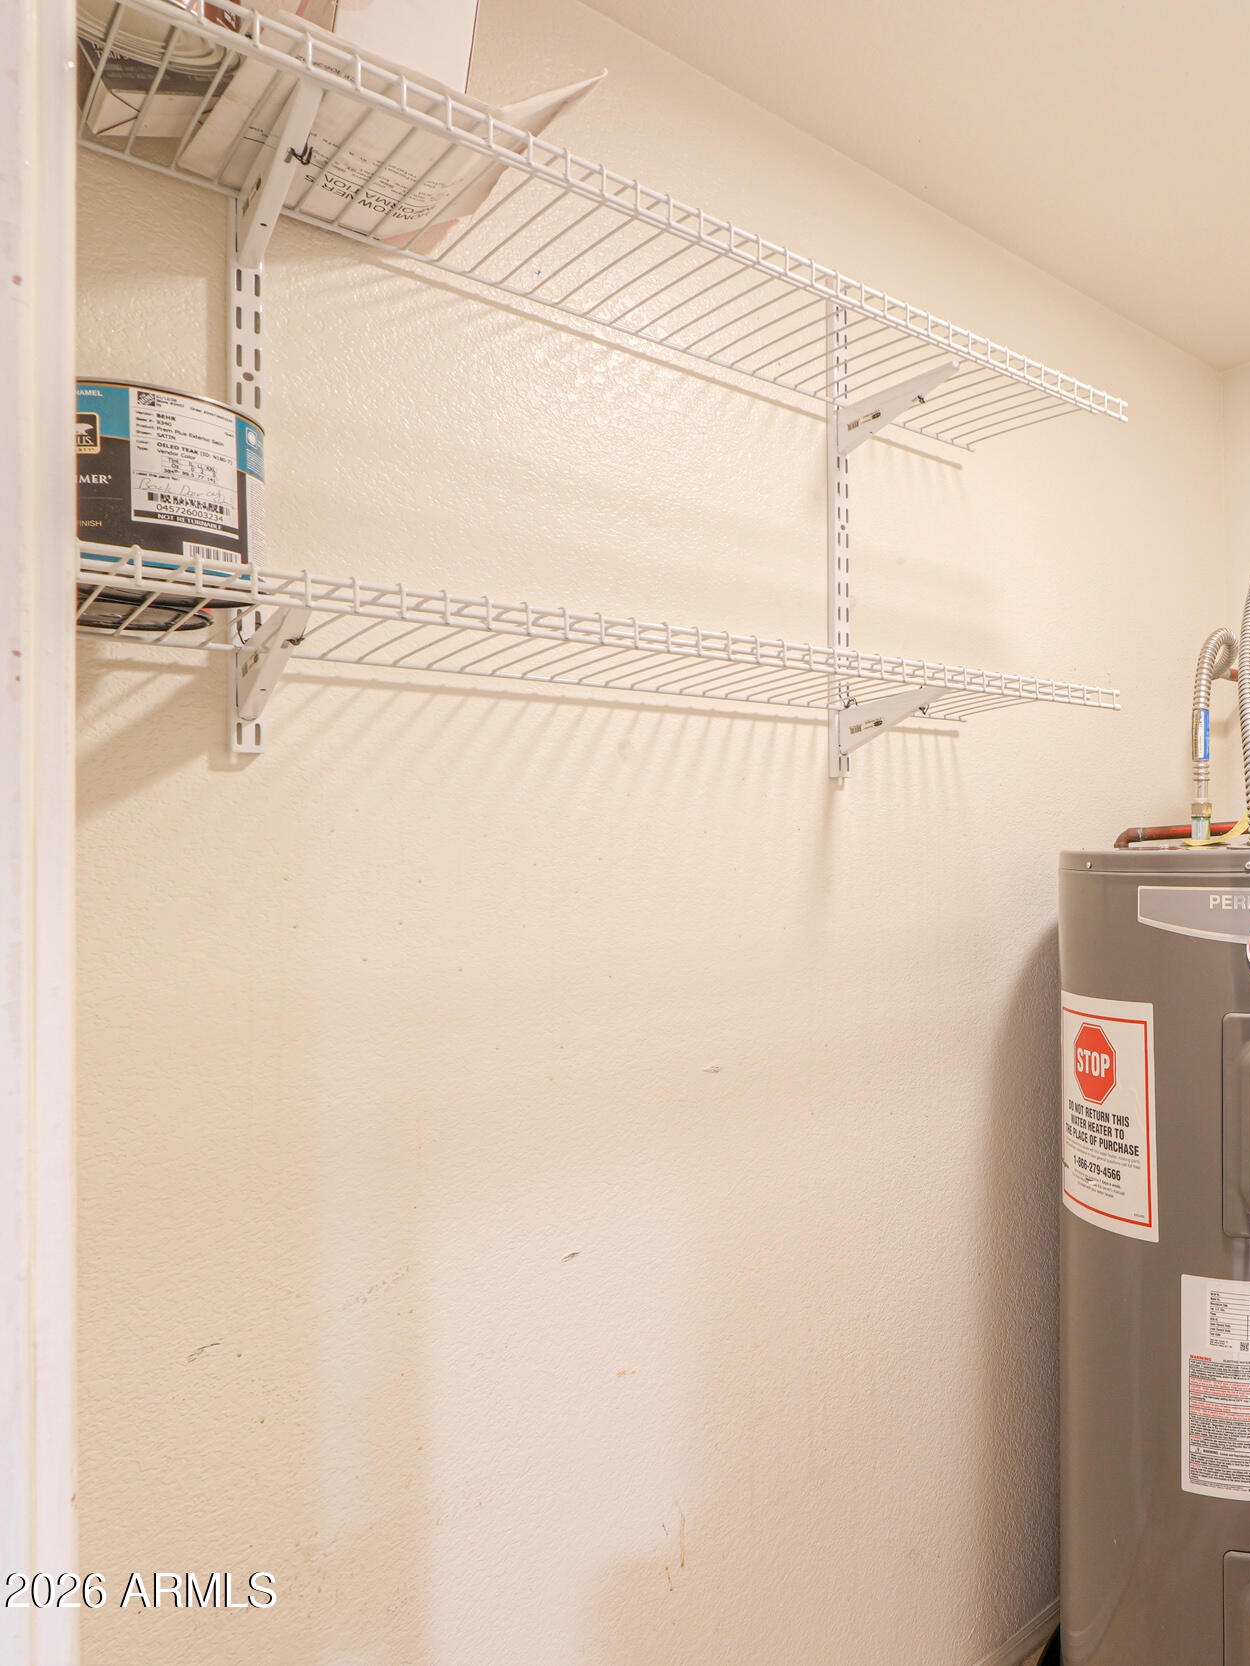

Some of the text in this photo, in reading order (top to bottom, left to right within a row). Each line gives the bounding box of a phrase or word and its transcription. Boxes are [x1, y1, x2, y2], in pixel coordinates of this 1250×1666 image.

[76, 389, 103, 397] AMEL
[189, 433, 209, 442] Exterior
[79, 474, 111, 485] MER
[156, 504, 223, 521] 045726003234
[1076, 1049, 1111, 1079] STOP
[1069, 1099, 1129, 1127] DO NOT RETURN THIS
[1071, 1114, 1124, 1140] WATER HEATER TO
[1073, 1128, 1087, 1143] PLACE
[1090, 1135, 1097, 1146] OF
[1099, 1138, 1139, 1156] PURCHASE
[1074, 1155, 1120, 1180] 1-866-279-4566
